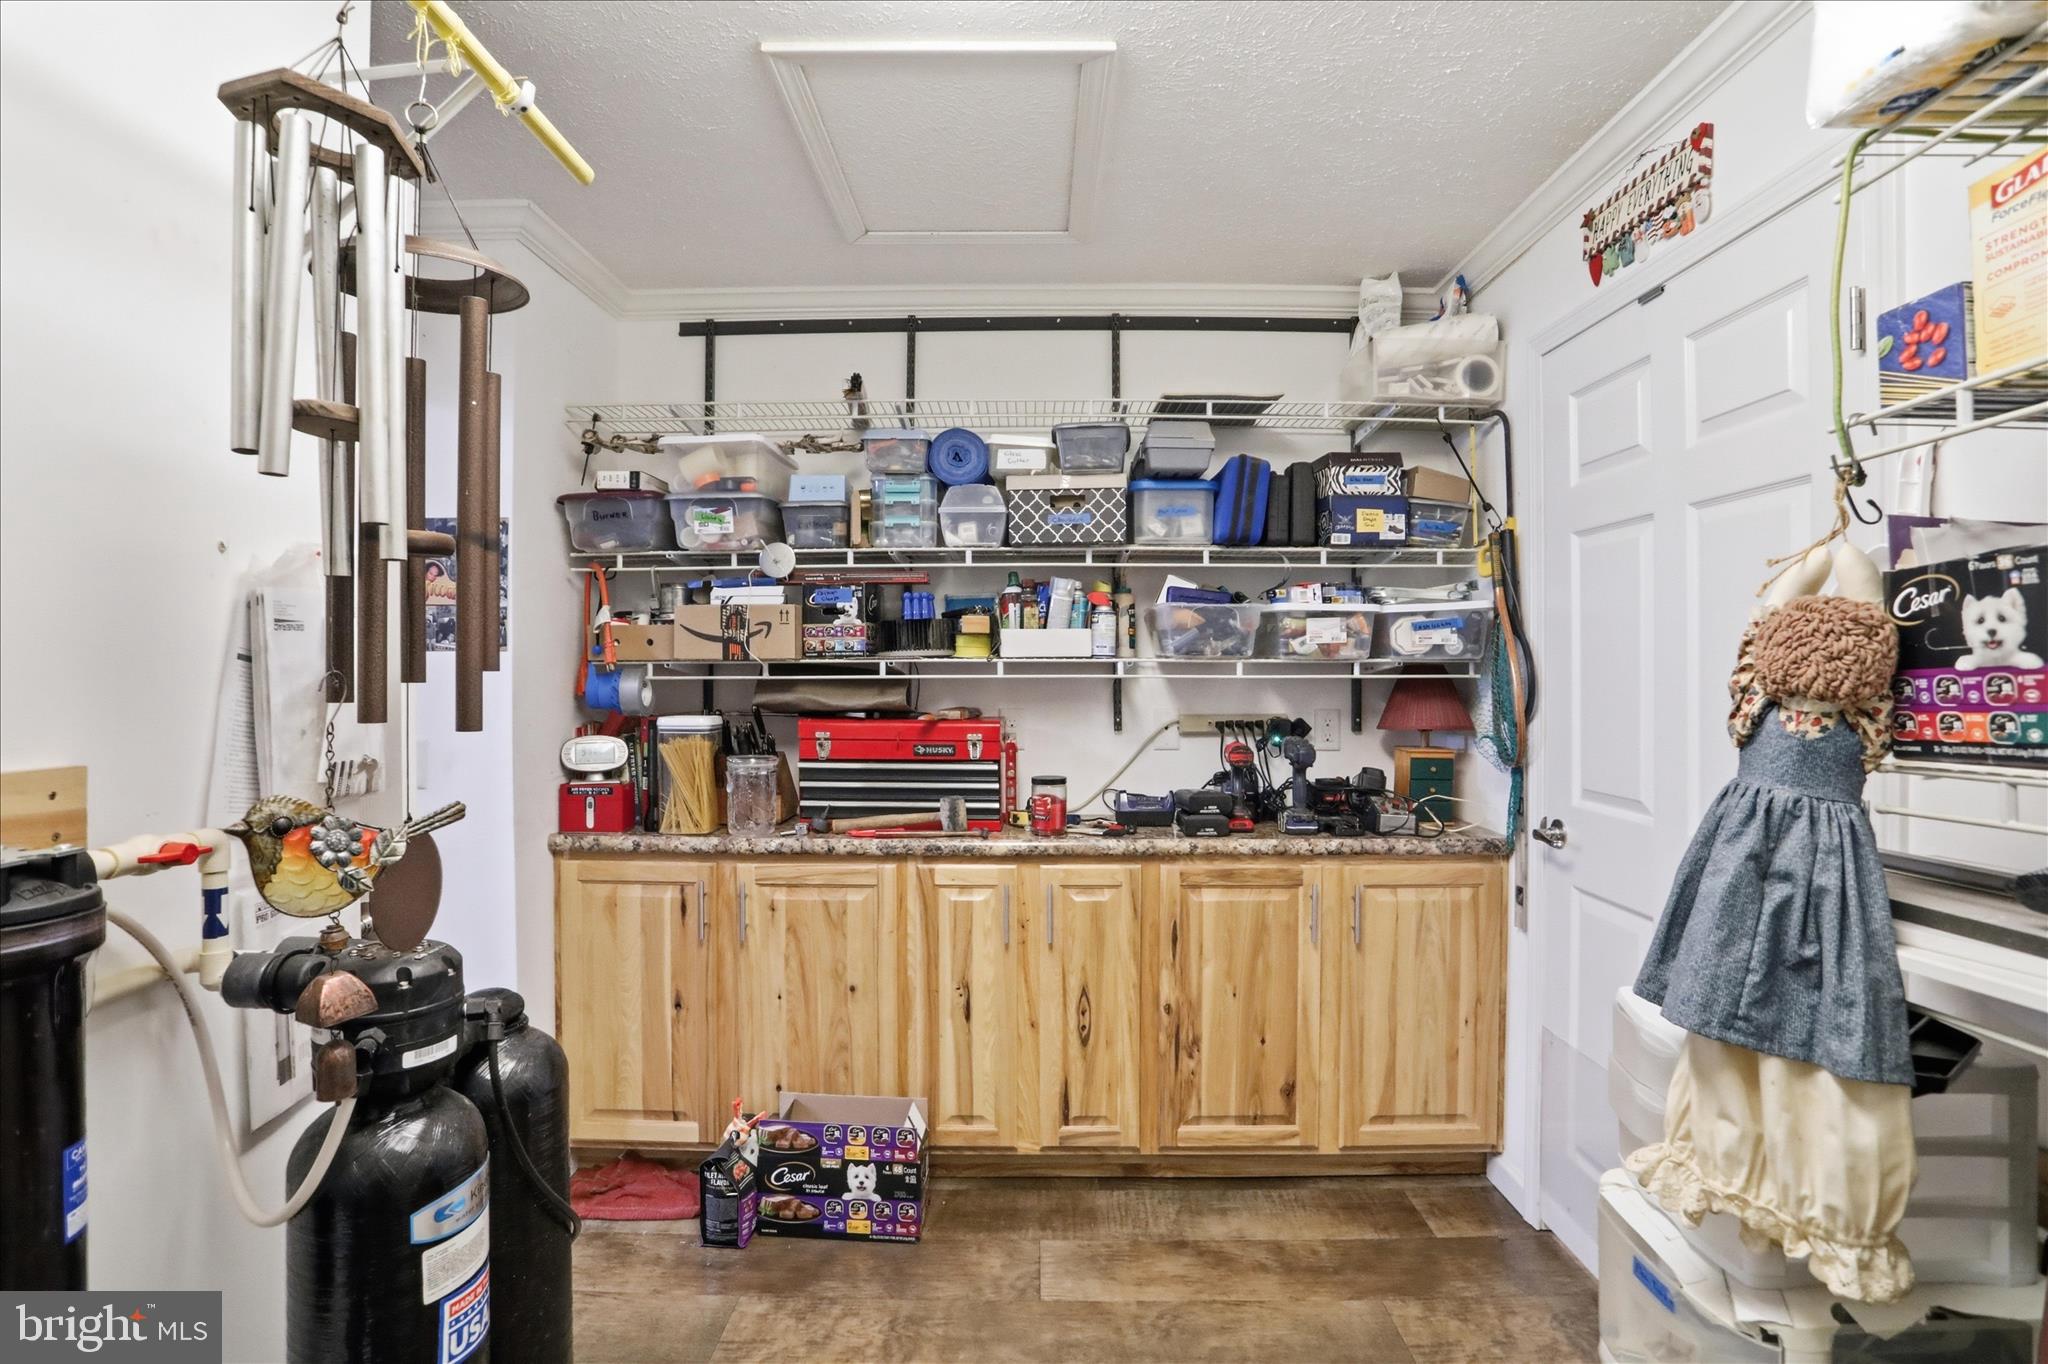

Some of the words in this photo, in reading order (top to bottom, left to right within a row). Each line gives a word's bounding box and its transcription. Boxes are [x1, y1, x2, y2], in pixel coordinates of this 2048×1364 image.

[1592, 202, 1623, 244] HAPPY
[1627, 149, 1693, 216] EVERYTHING
[1893, 586, 1951, 617] Cesar
[771, 1166, 811, 1185] Cesar
